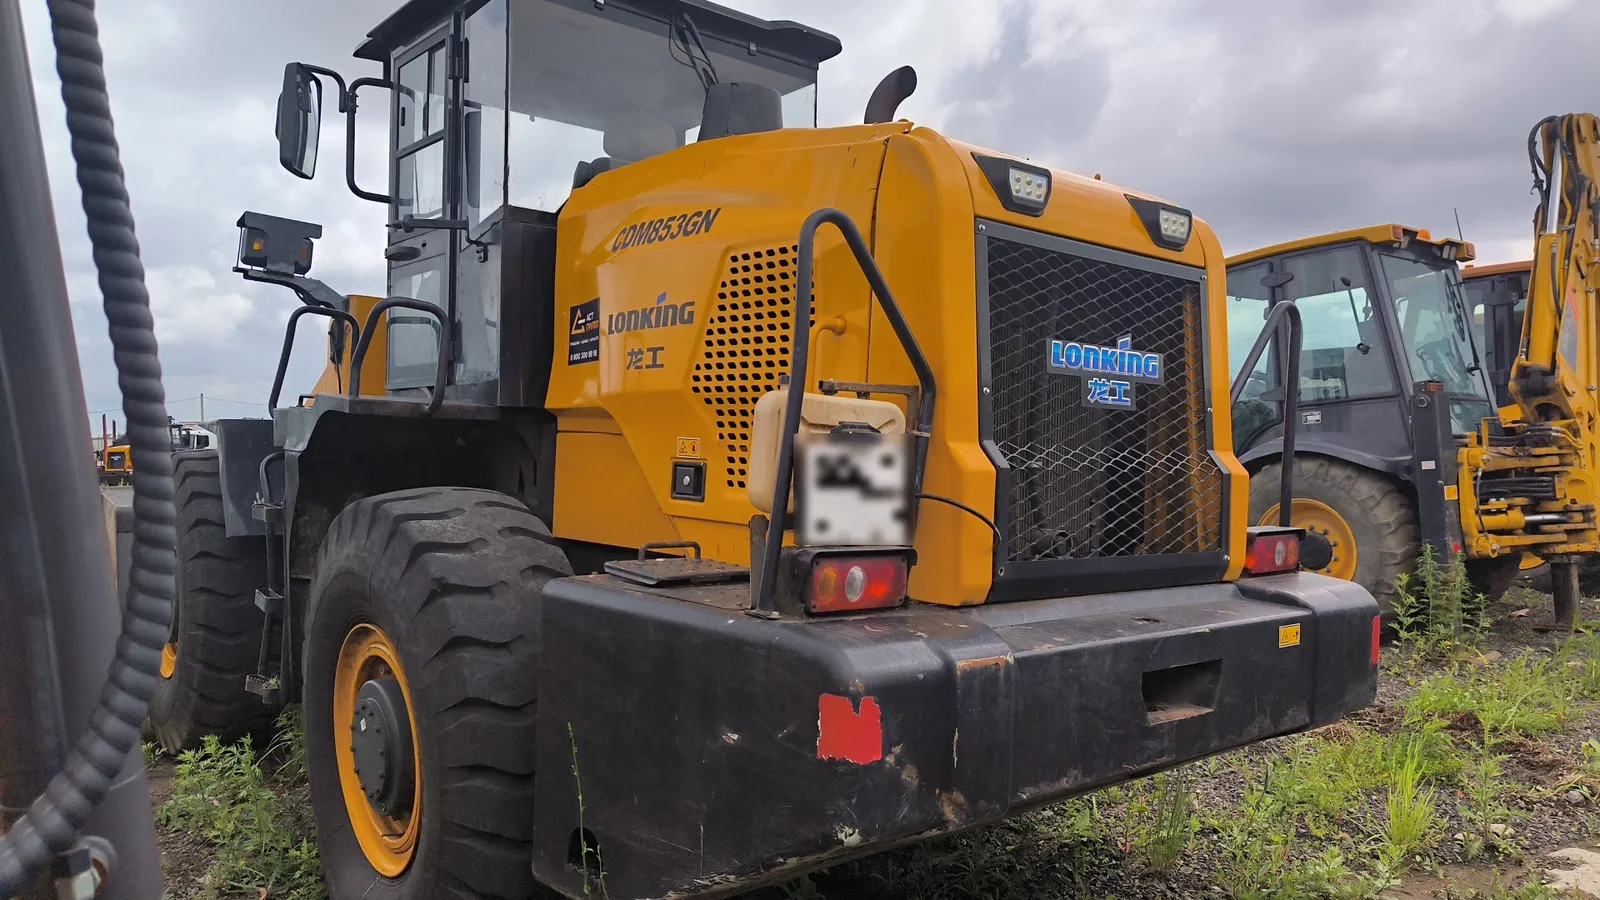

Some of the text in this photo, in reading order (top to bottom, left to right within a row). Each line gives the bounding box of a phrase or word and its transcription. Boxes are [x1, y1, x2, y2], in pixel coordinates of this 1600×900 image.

[611, 207, 722, 253] CDM853GN
[627, 346, 665, 370] 龙工
[1087, 378, 1131, 406] 龙工
